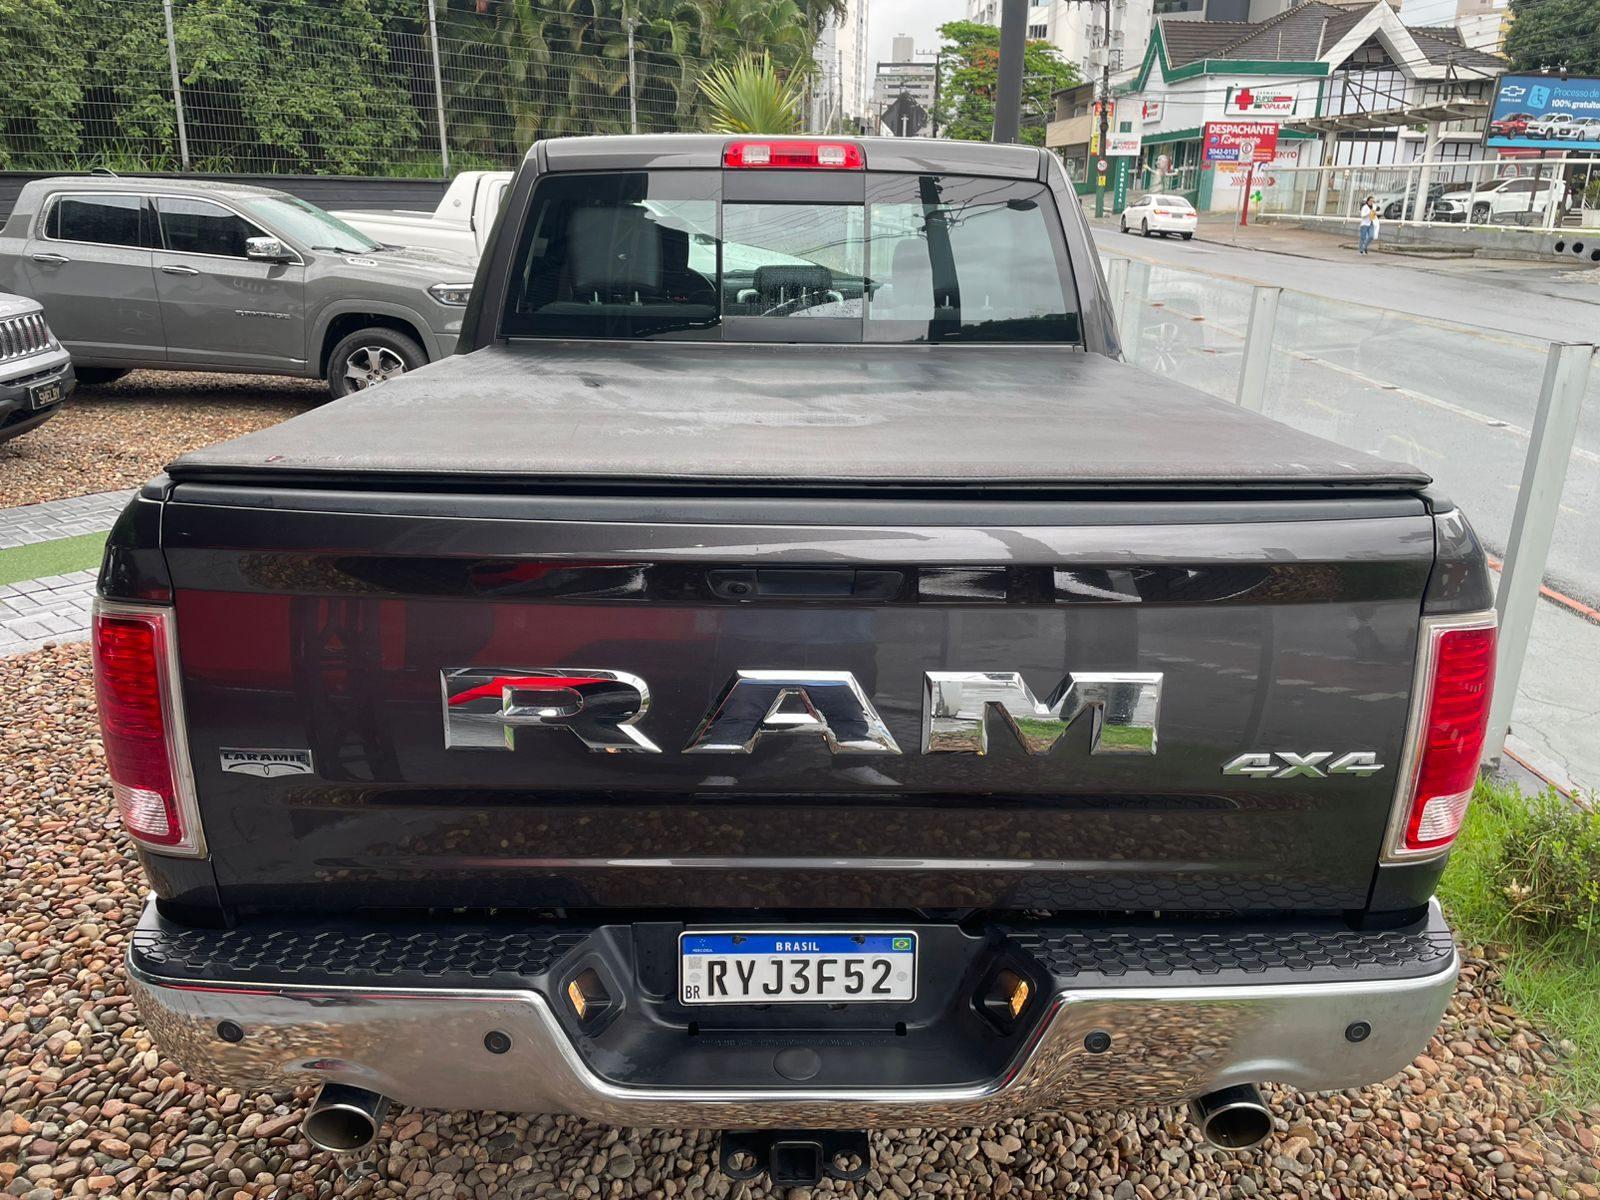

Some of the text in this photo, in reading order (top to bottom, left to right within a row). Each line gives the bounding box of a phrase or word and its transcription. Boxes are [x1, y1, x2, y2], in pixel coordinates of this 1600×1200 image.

[1553, 87, 1600, 98] Processo de
[1551, 99, 1571, 108] 100%
[1209, 124, 1276, 135] DESPACHANTE
[440, 668, 1163, 755] RAM
[223, 751, 307, 762] LARAMIE
[776, 941, 819, 951] BRASIL
[708, 959, 892, 996] RYJ3F52
[685, 985, 701, 1000] BR
